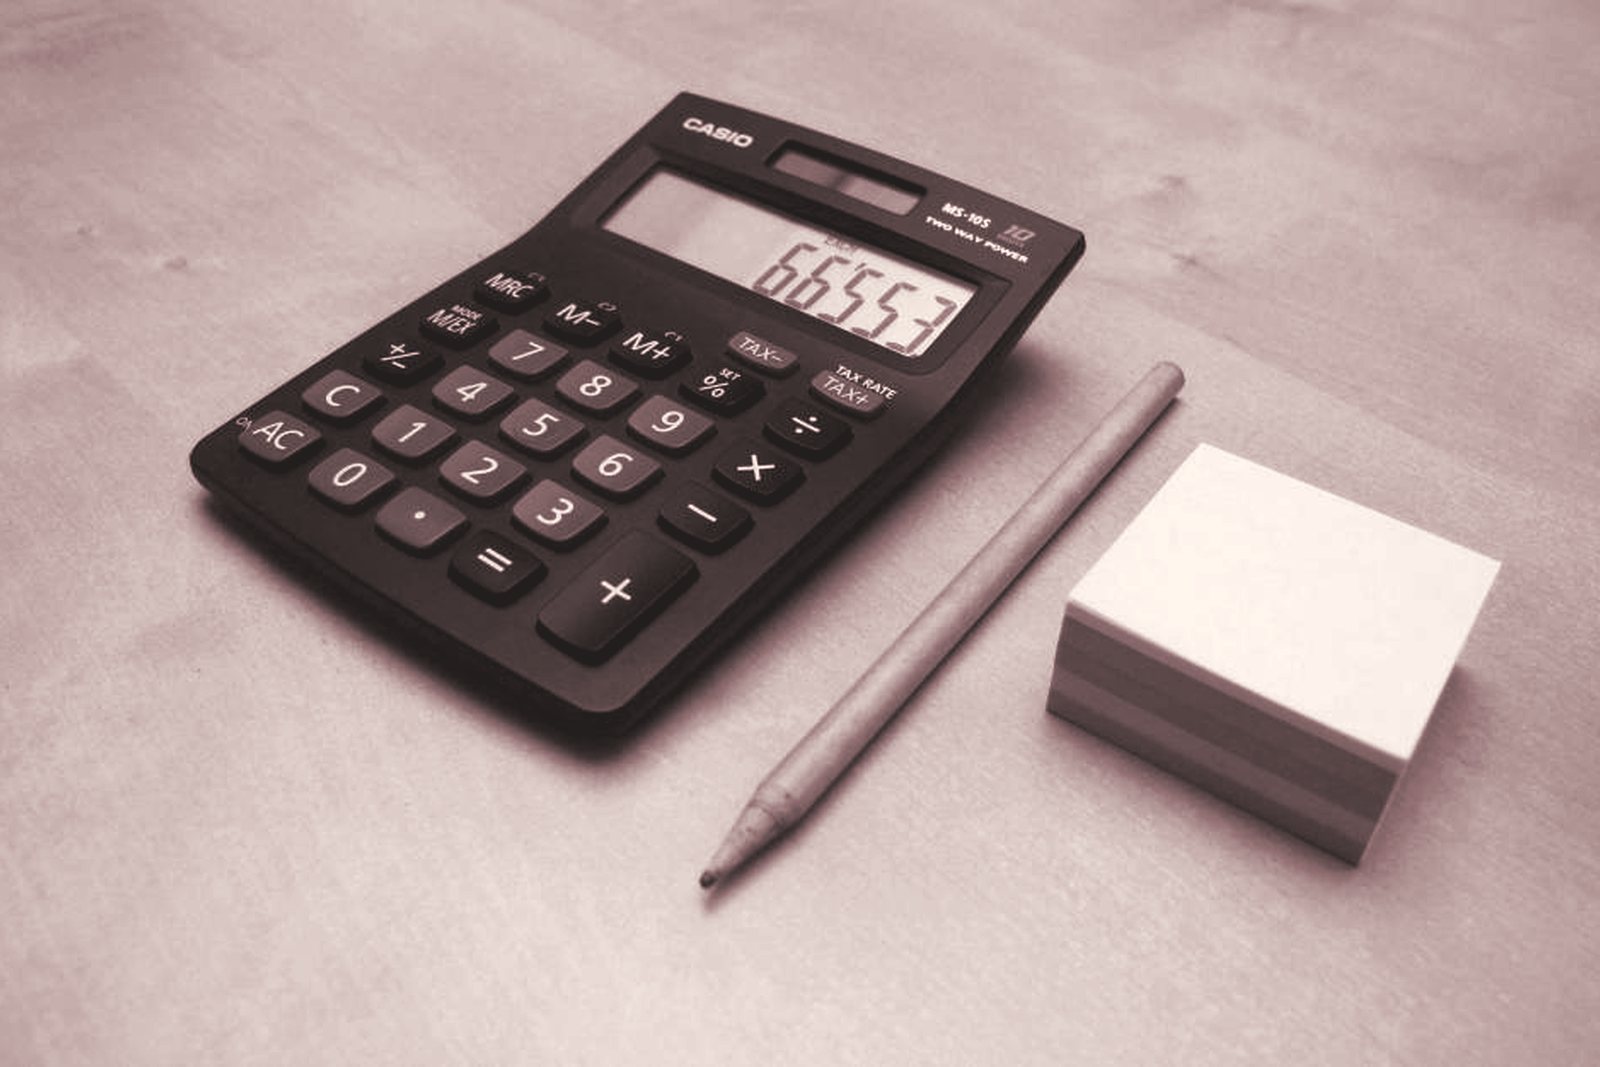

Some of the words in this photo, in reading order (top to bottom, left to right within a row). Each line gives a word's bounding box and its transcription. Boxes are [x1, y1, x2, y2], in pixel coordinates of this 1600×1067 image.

[682, 116, 755, 149] CASIO
[941, 203, 992, 229] MS-10S
[926, 216, 953, 231] TWO
[954, 228, 984, 243] WAY
[984, 241, 1028, 263] POWER
[484, 273, 535, 298] MRC
[512, 341, 545, 361] 7
[621, 331, 671, 360] M+
[579, 374, 613, 397] 8
[699, 375, 729, 398] %
[718, 367, 742, 381] SET
[836, 364, 863, 384] TAX
[862, 378, 898, 400] RATE
[325, 384, 361, 407] C
[455, 381, 488, 402] 4
[824, 375, 869, 405] TAX+
[398, 421, 427, 443] 1
[521, 413, 560, 436] 5
[651, 410, 685, 433] 9
[252, 422, 305, 450] AC
[332, 462, 367, 487] 0
[460, 456, 499, 485] 2
[597, 452, 634, 477] 6
[536, 497, 575, 525] 3
[600, 577, 632, 604] +
